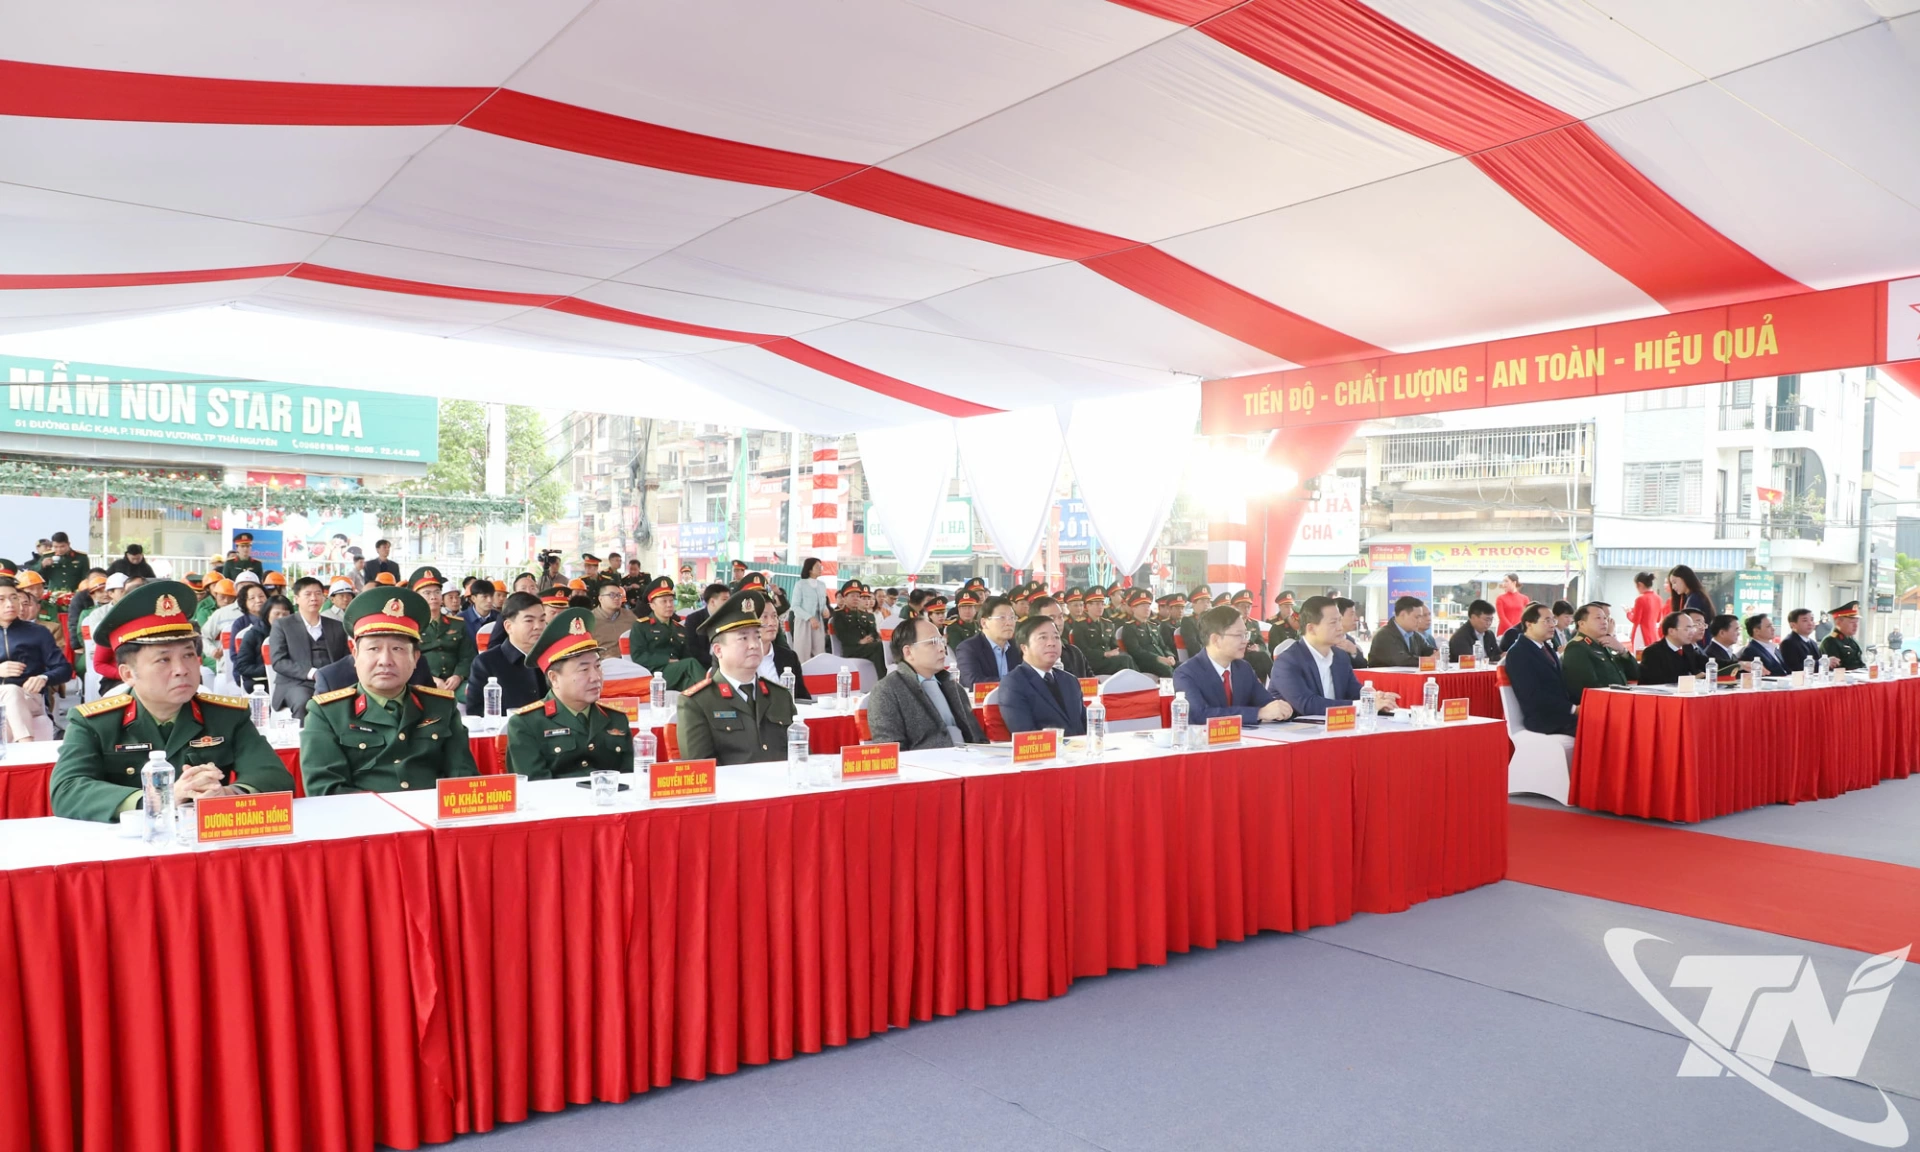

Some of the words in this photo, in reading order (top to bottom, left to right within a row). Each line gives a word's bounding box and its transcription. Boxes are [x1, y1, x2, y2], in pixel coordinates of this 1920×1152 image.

[1244, 384, 1283, 416] TIẾN
[1289, 381, 1315, 415] ĐỘ
[1335, 369, 1387, 406] CHẤT
[1394, 366, 1468, 402] LƯỢNG
[1492, 358, 1527, 388] AN
[1535, 345, 1605, 383] TOÀN
[1634, 331, 1702, 374] HIỆU
[1713, 313, 1779, 364] QUẢ
[120, 379, 196, 424] NON
[206, 387, 292, 433] STAR
[302, 396, 363, 438] DPA
[15, 420, 27, 428] 51
[1450, 545, 1472, 557] BÀ
[657, 772, 683, 788] NGUYỄN
[683, 770, 696, 786] THẾ
[695, 772, 708, 787] LỰC
[236, 800, 247, 808] ĐẠI
[248, 798, 257, 806] TÁ
[443, 792, 456, 807] VÕ
[458, 788, 484, 806] KHẮC
[486, 789, 512, 804] HÙNG
[204, 812, 234, 829] DƯƠNG
[235, 808, 265, 826] HOÀNG
